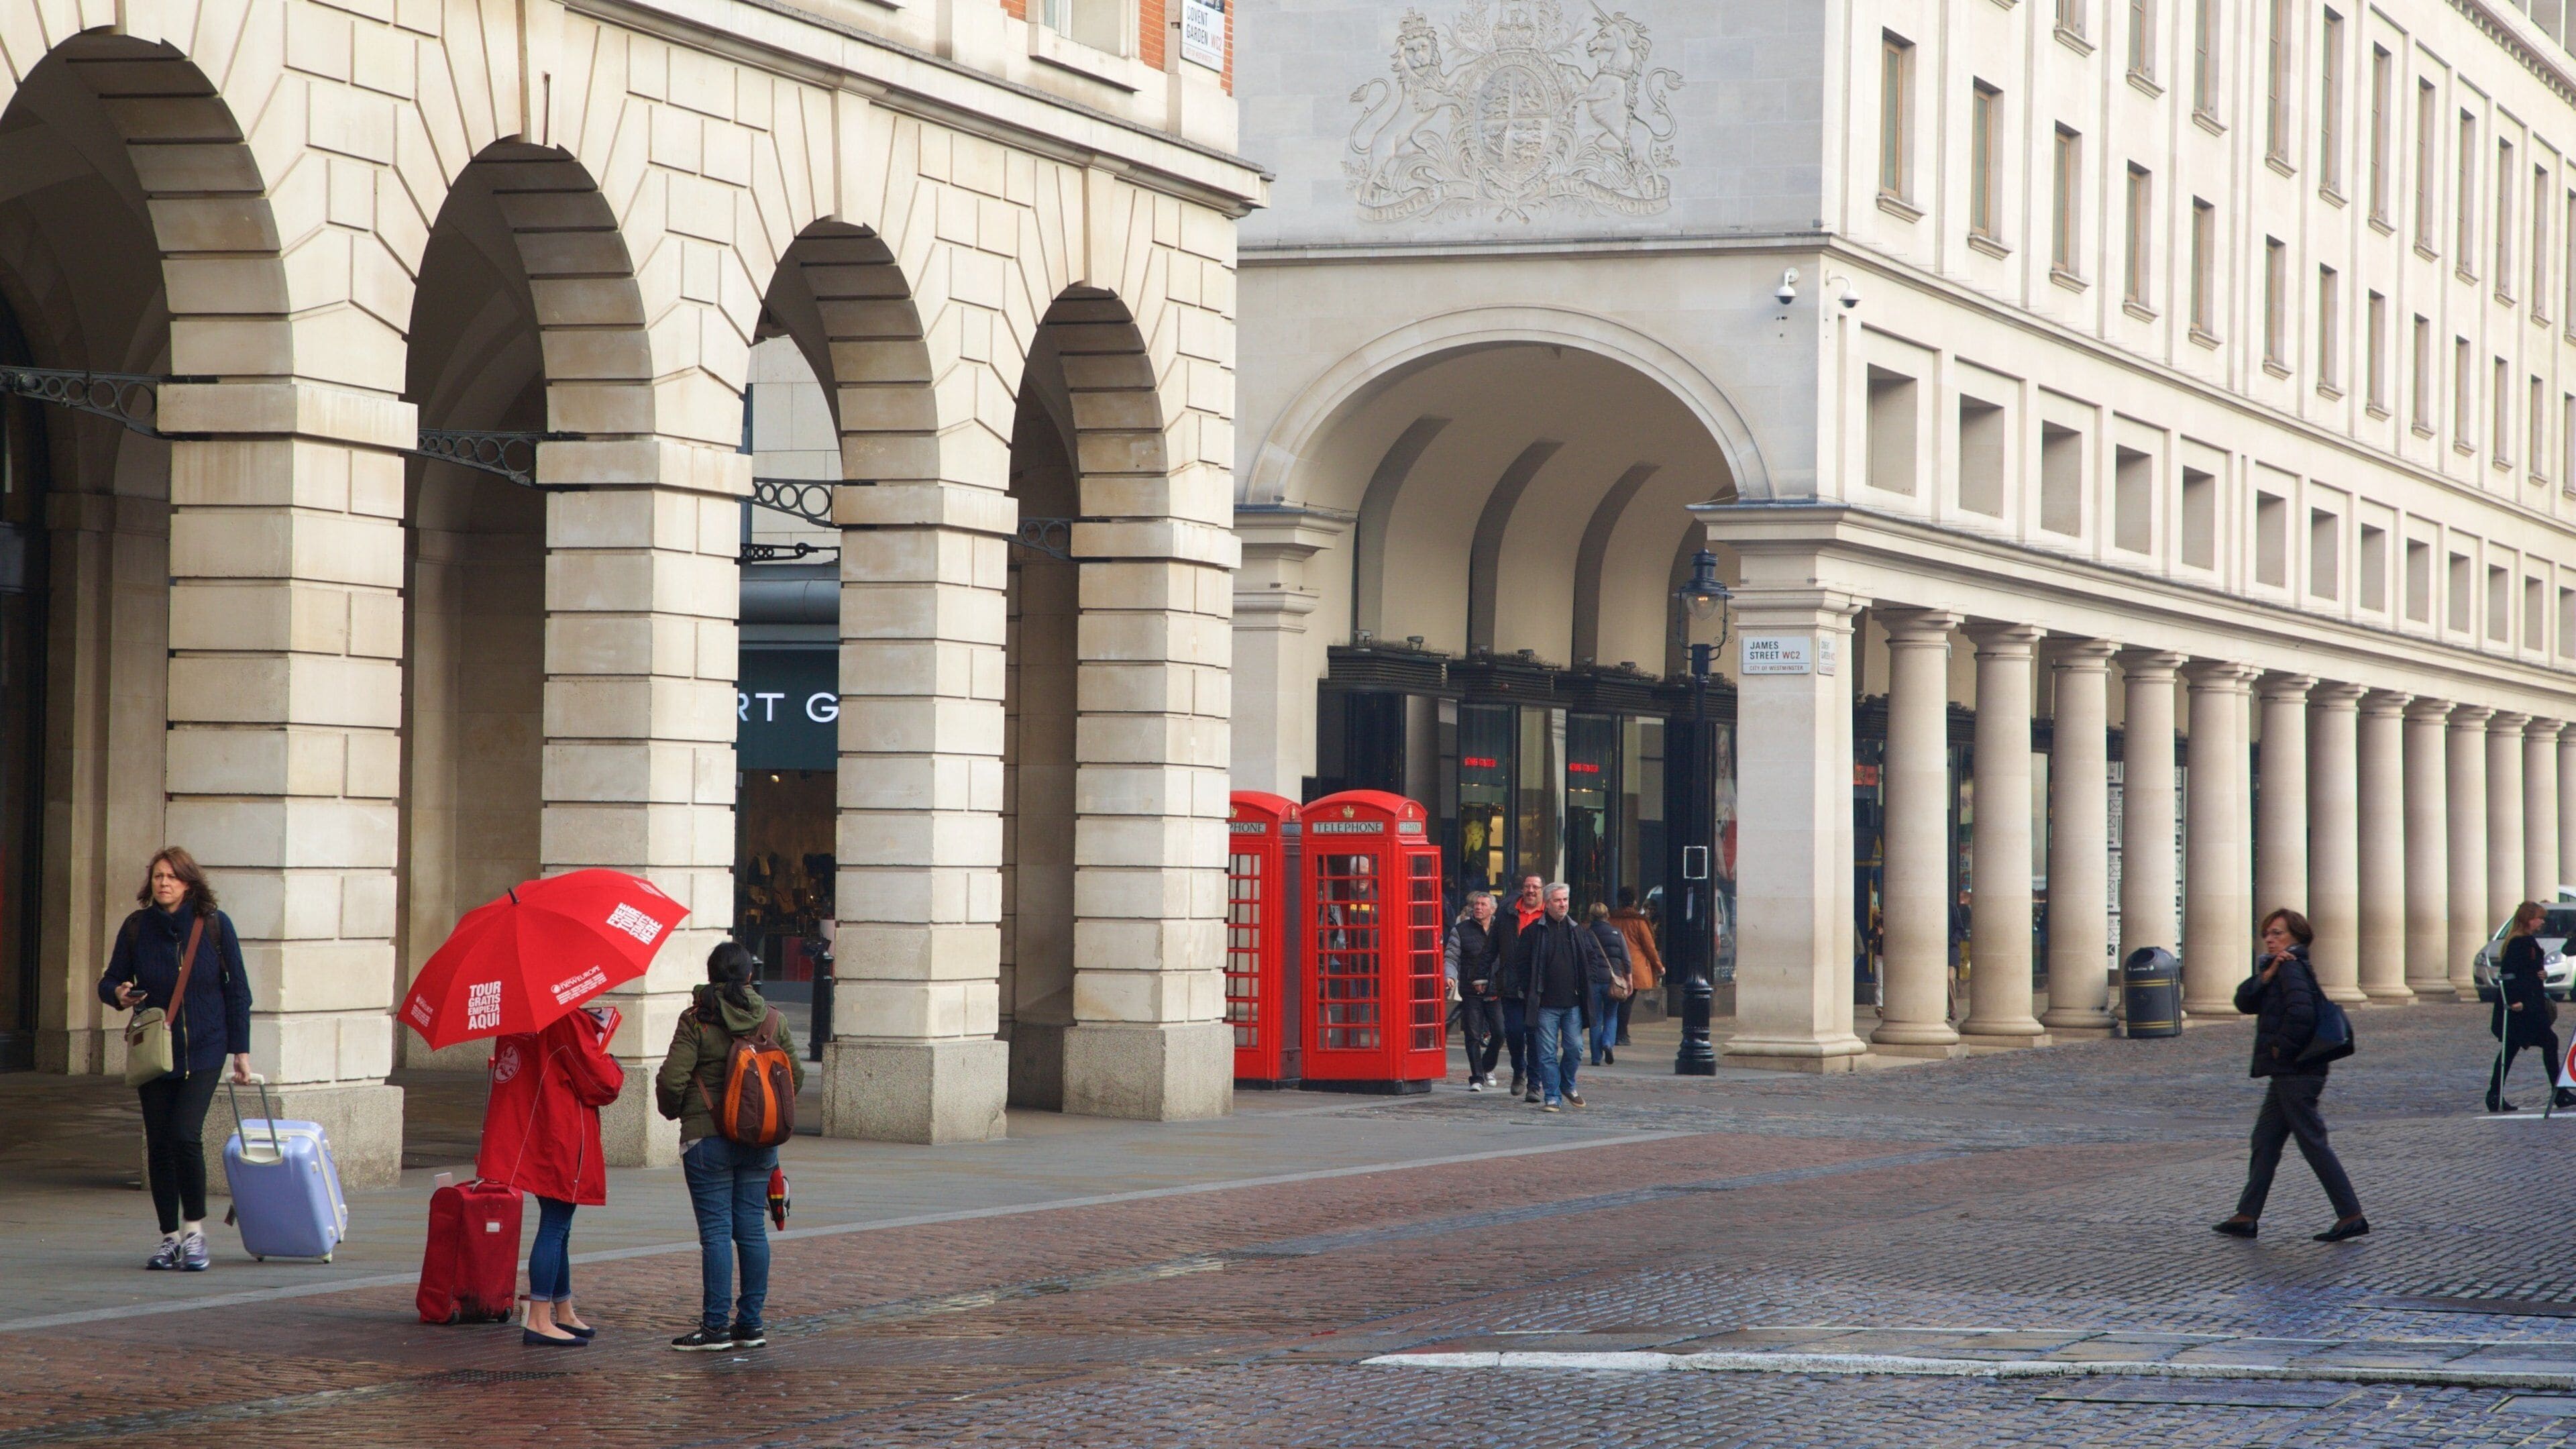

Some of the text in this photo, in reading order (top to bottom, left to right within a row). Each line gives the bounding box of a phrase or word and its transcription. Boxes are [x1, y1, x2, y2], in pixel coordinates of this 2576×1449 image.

[1186, 5, 1208, 27] COVENT
[1186, 23, 1223, 52] GARDEN WC2
[1750, 641, 1779, 649] JAMES
[1750, 651, 1801, 659] STREET WC2
[806, 692, 839, 723] G
[1316, 822, 1382, 833] TELEPHONE
[606, 902, 631, 928] FREE
[618, 907, 643, 932] TOUR
[629, 914, 651, 937] STARTS
[637, 918, 663, 945] HERE
[469, 981, 502, 998] TOUR
[468, 993, 501, 1008] GRATIS
[468, 1003, 500, 1016] EMPIEZA
[468, 1012, 500, 1030] AQUÍ
